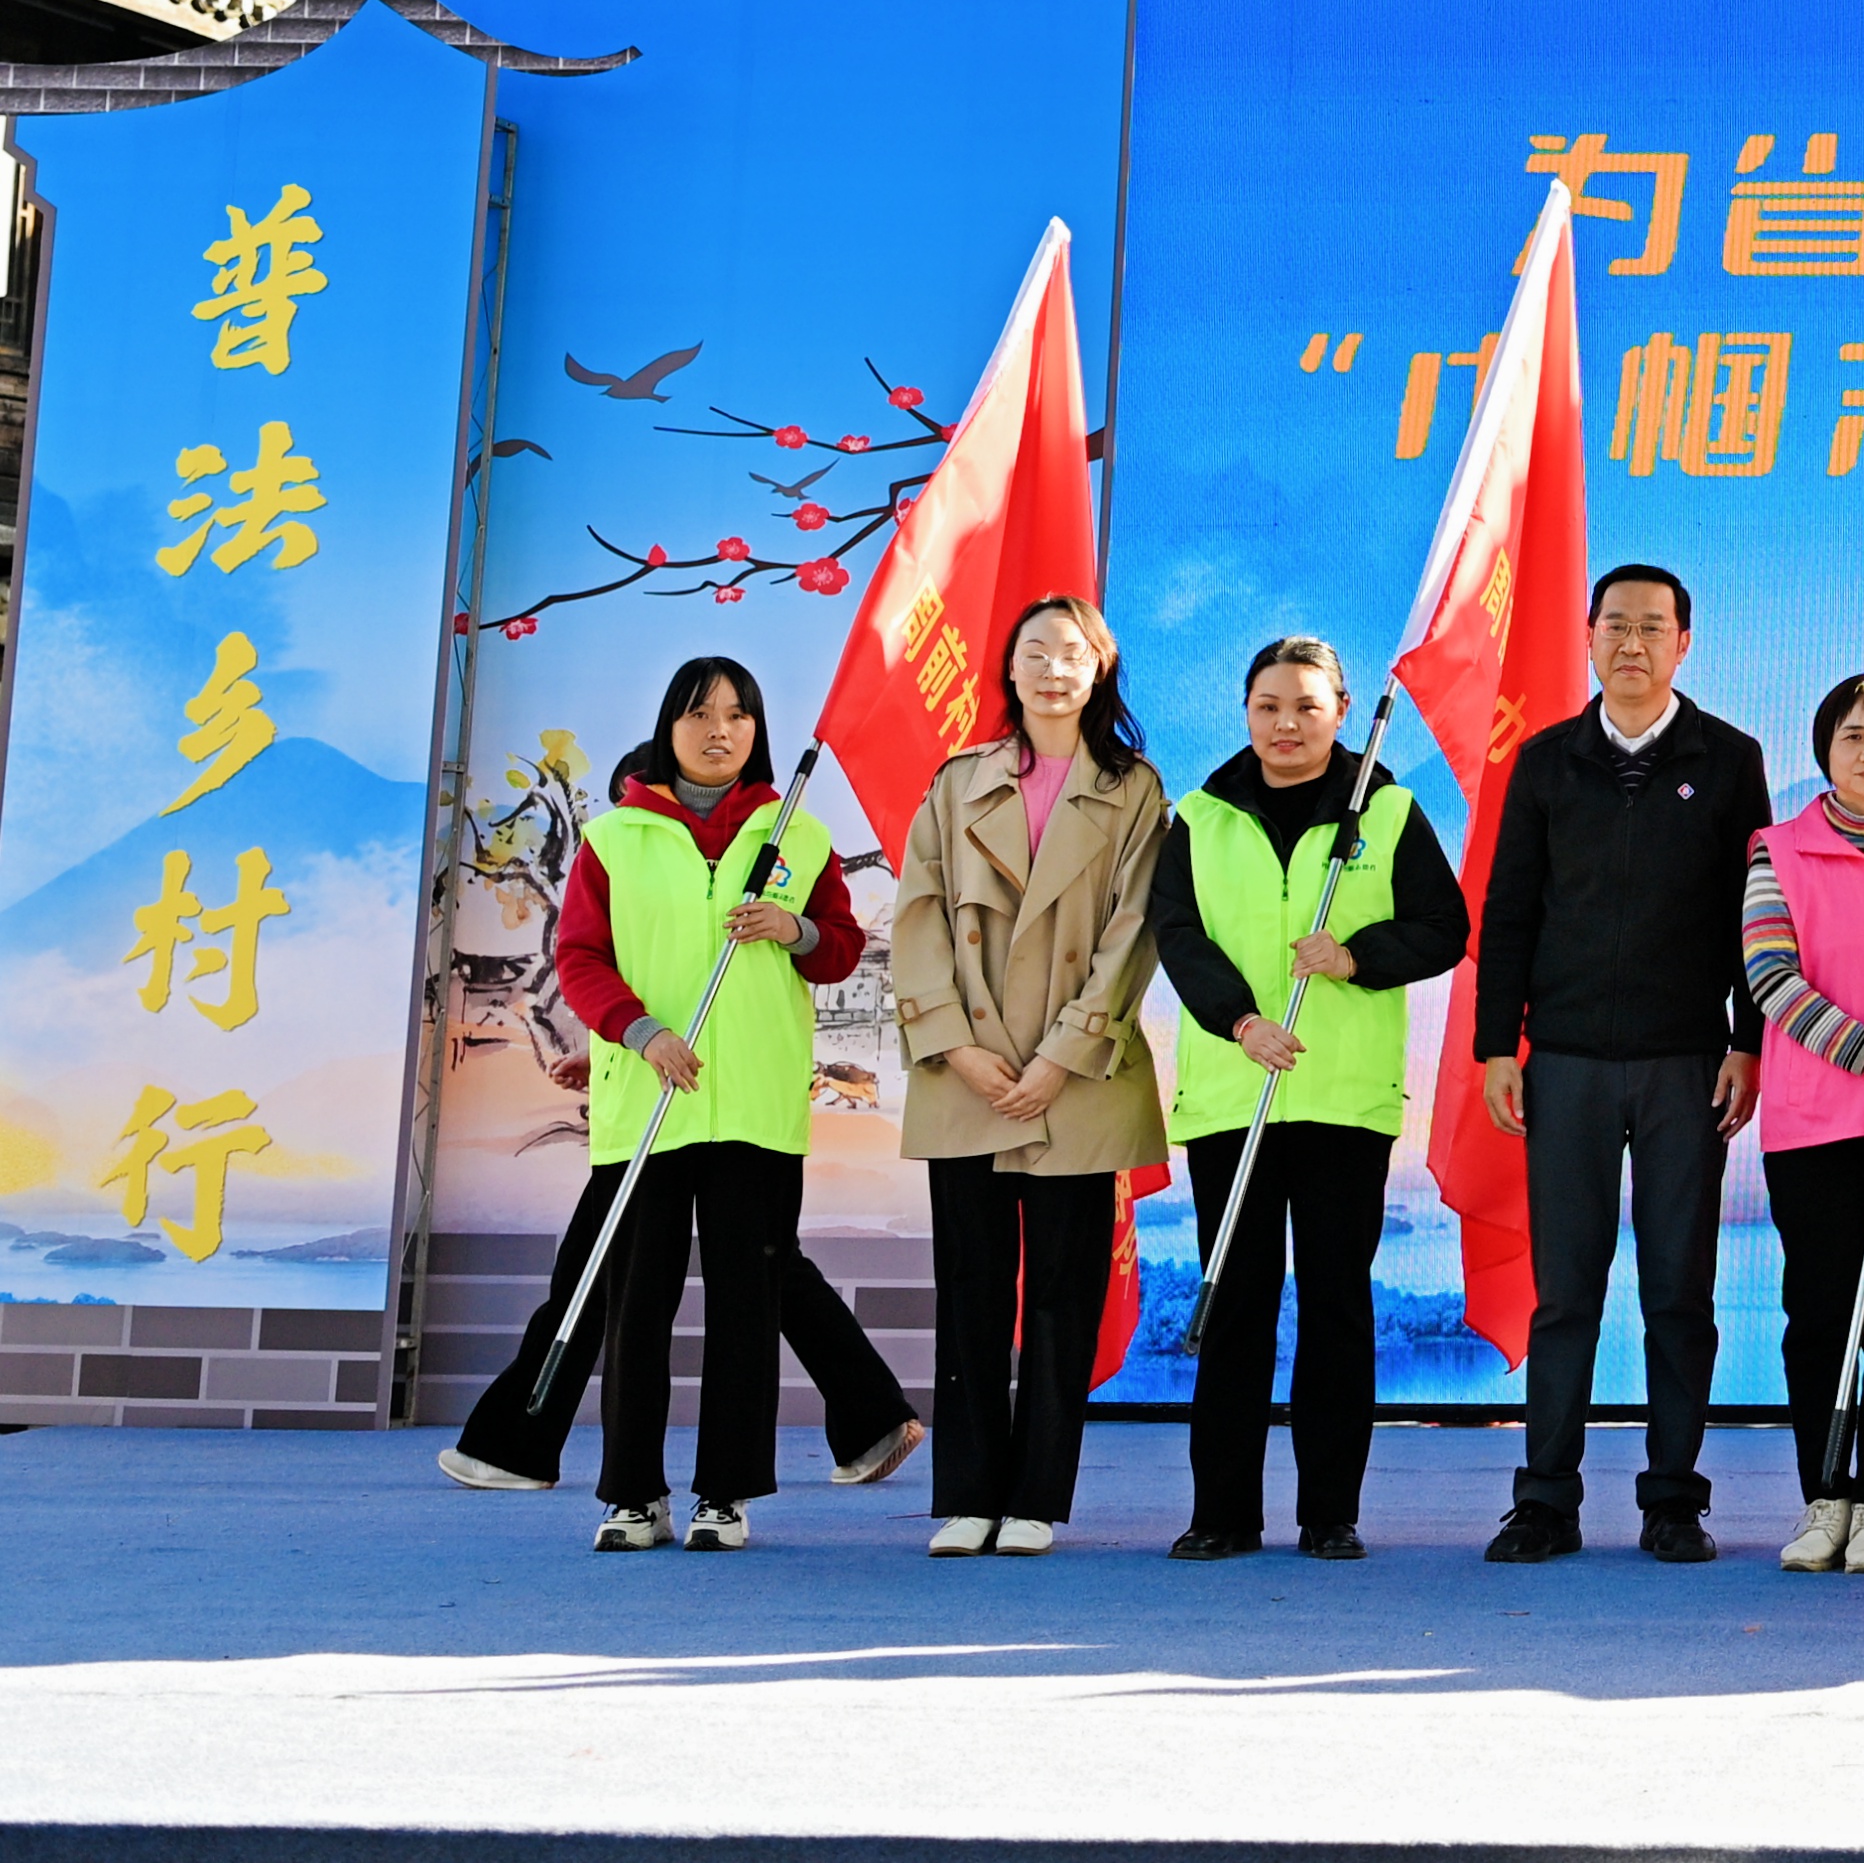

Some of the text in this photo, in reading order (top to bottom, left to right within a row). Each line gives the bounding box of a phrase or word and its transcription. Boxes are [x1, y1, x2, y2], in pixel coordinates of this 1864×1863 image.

[101, 184, 331, 1263] 普法乡村行
[901, 572, 981, 758] 周前村
